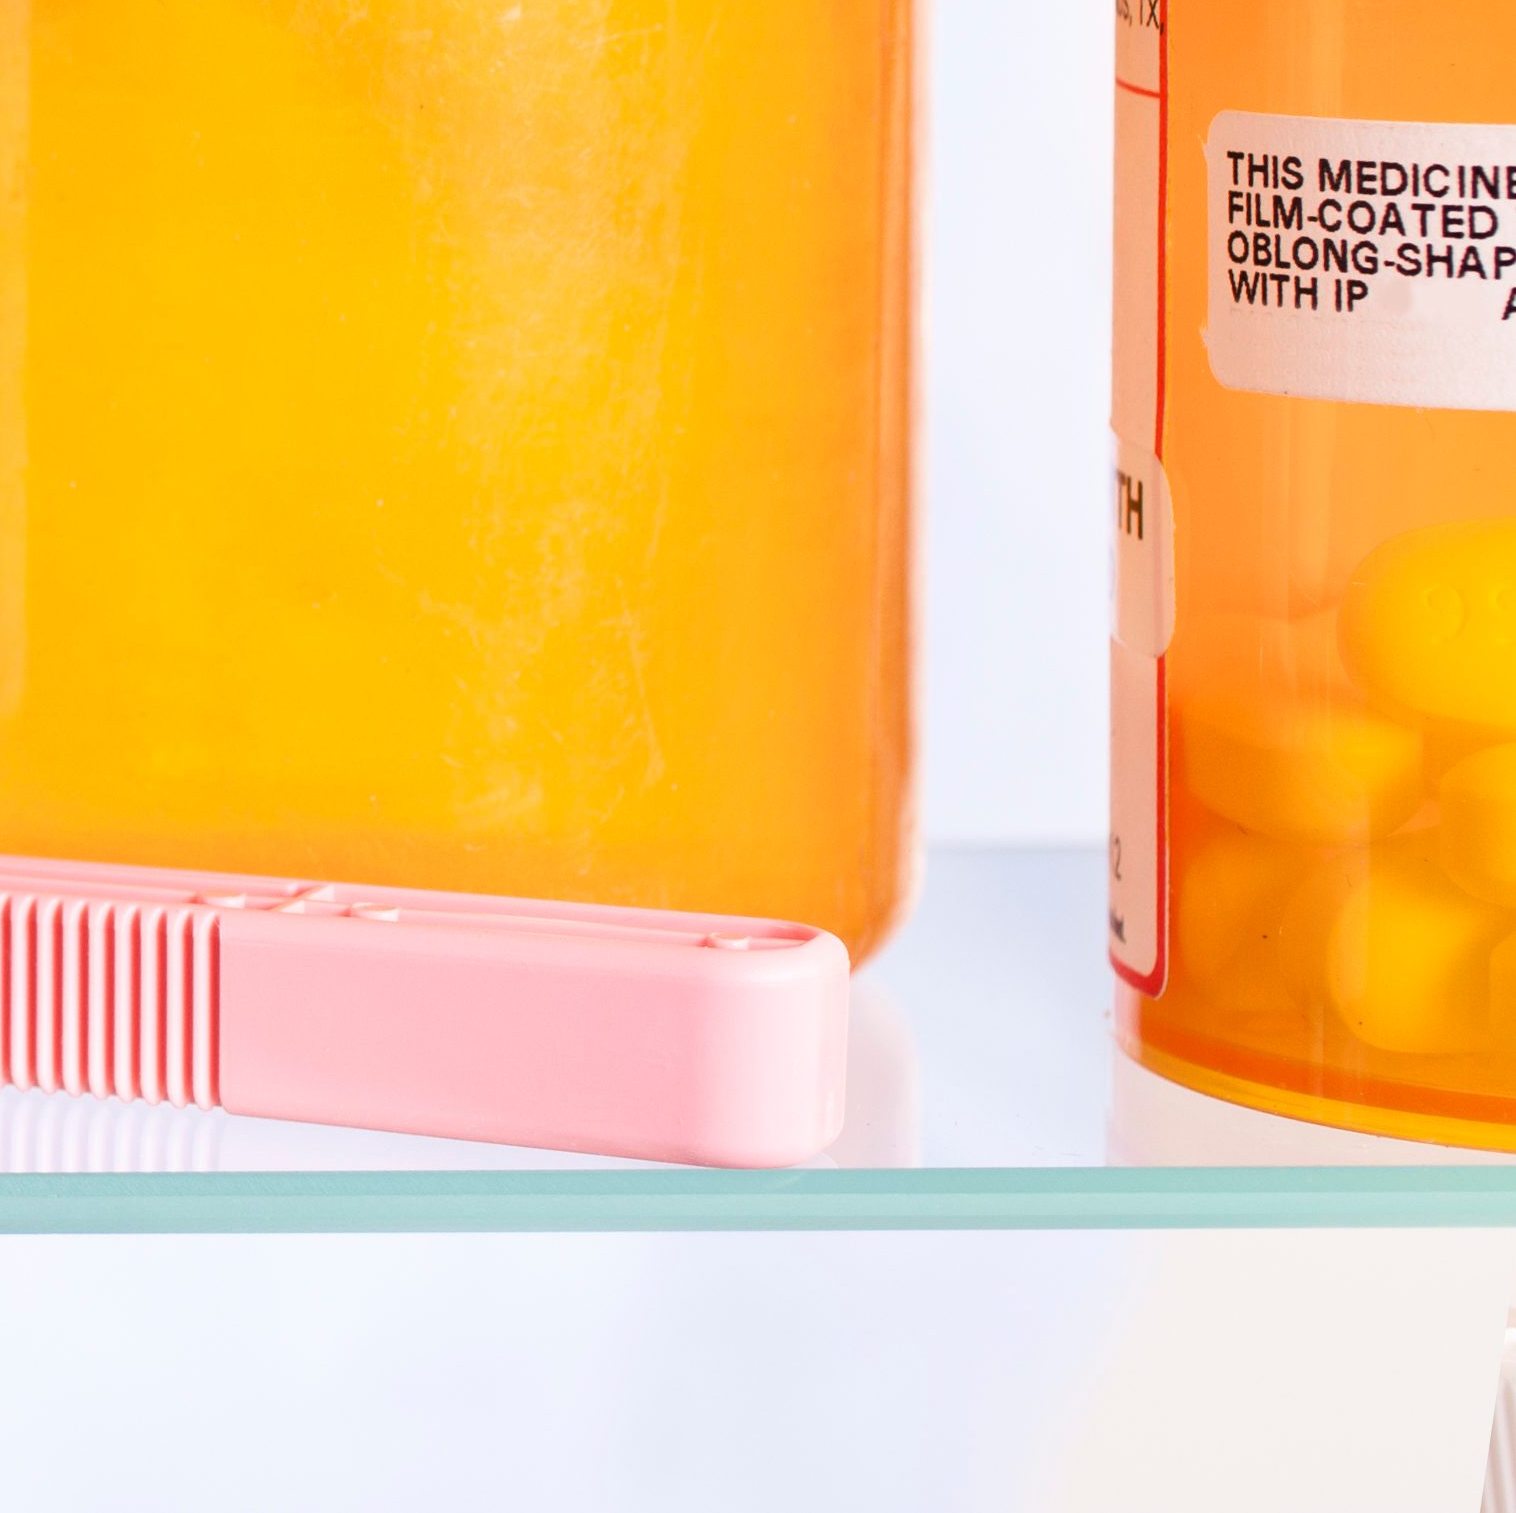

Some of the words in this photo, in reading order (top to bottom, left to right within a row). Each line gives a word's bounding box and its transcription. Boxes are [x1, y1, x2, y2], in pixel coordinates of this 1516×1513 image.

[1227, 152, 1305, 191] THIS
[1319, 158, 1516, 200] MEDICINE
[1227, 190, 1498, 239] FILM-COATED
[1227, 231, 1516, 280] OBLONG-SHAP
[1229, 268, 1318, 311] WITH
[1334, 282, 1369, 313] IP
